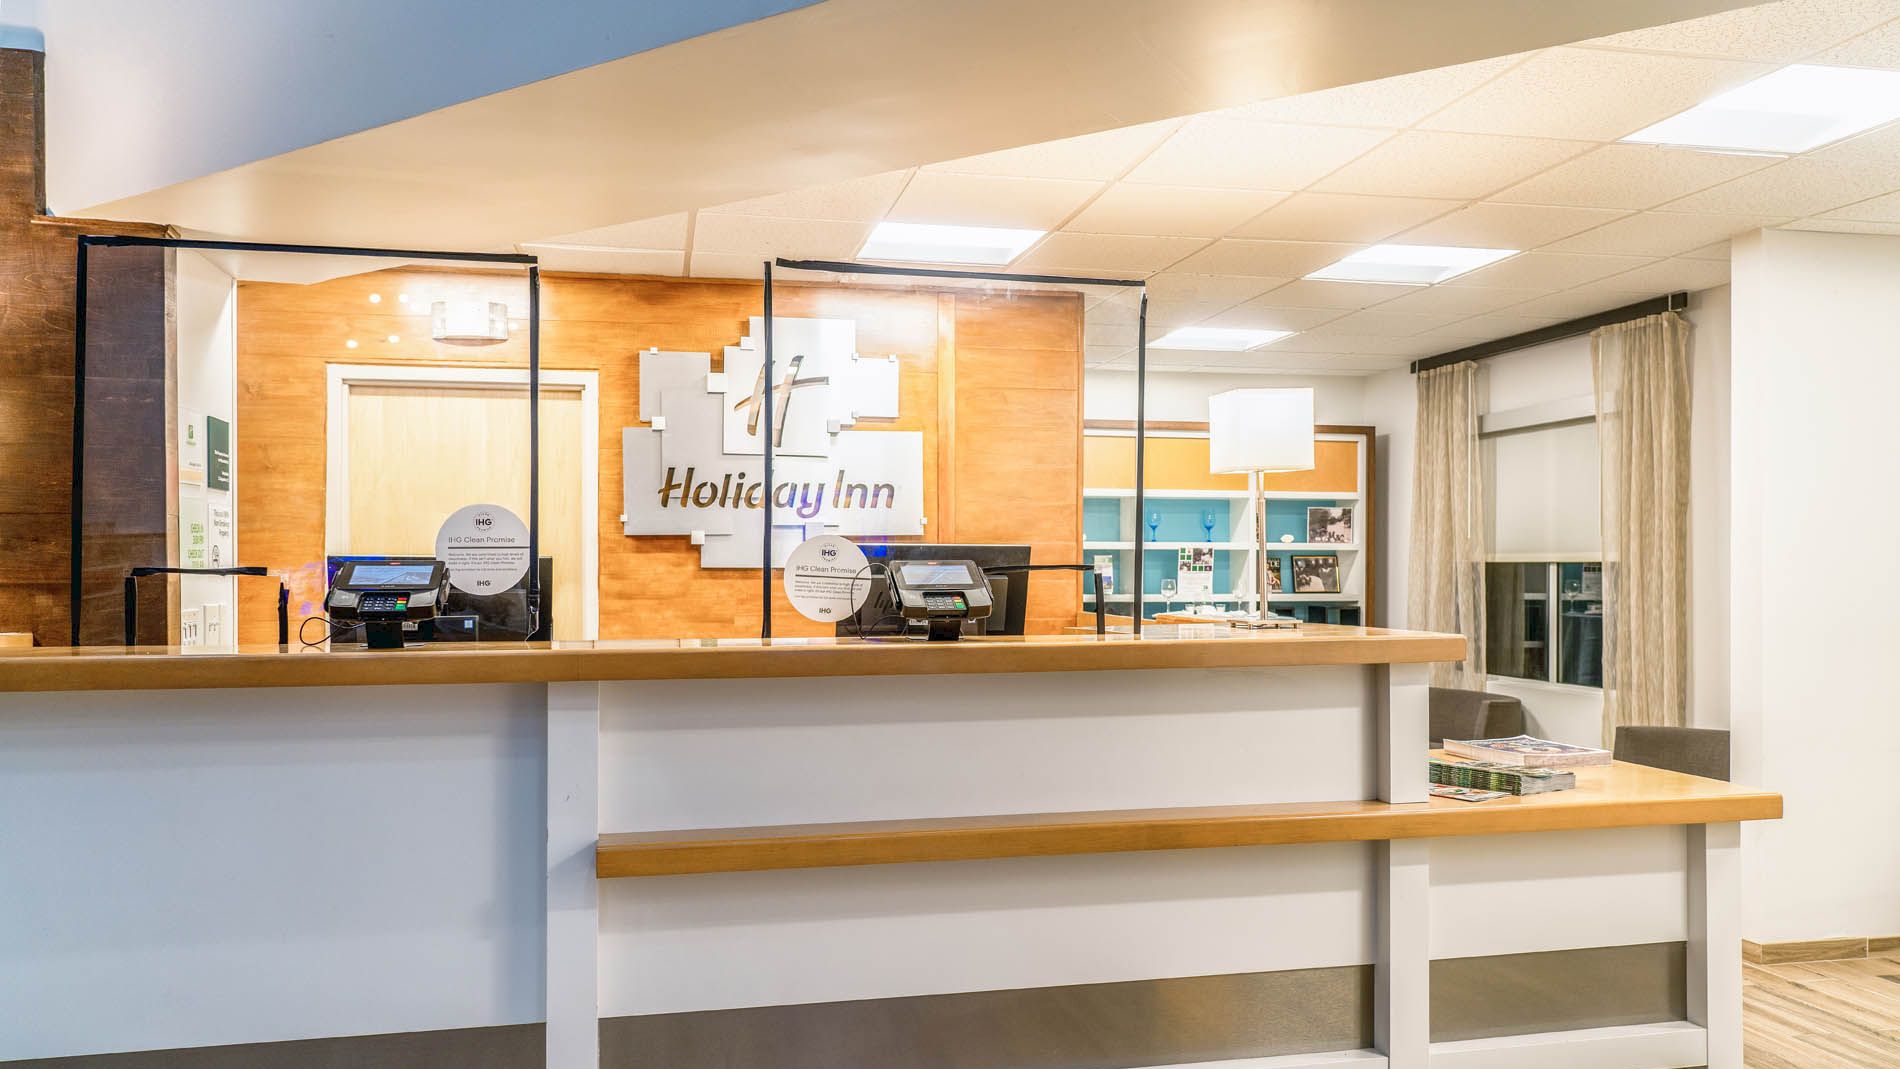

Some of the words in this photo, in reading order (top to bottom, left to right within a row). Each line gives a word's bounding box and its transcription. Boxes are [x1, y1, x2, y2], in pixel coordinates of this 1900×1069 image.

[657, 466, 826, 519] Holiday
[832, 468, 896, 509] Inn
[475, 518, 492, 526] IHG
[448, 536, 462, 544] IHG
[464, 536, 485, 544] Clean
[486, 536, 516, 544] Promise
[821, 549, 837, 557] IHG
[809, 565, 829, 573] Clean
[830, 566, 857, 575] Promise
[476, 579, 491, 587] IHG
